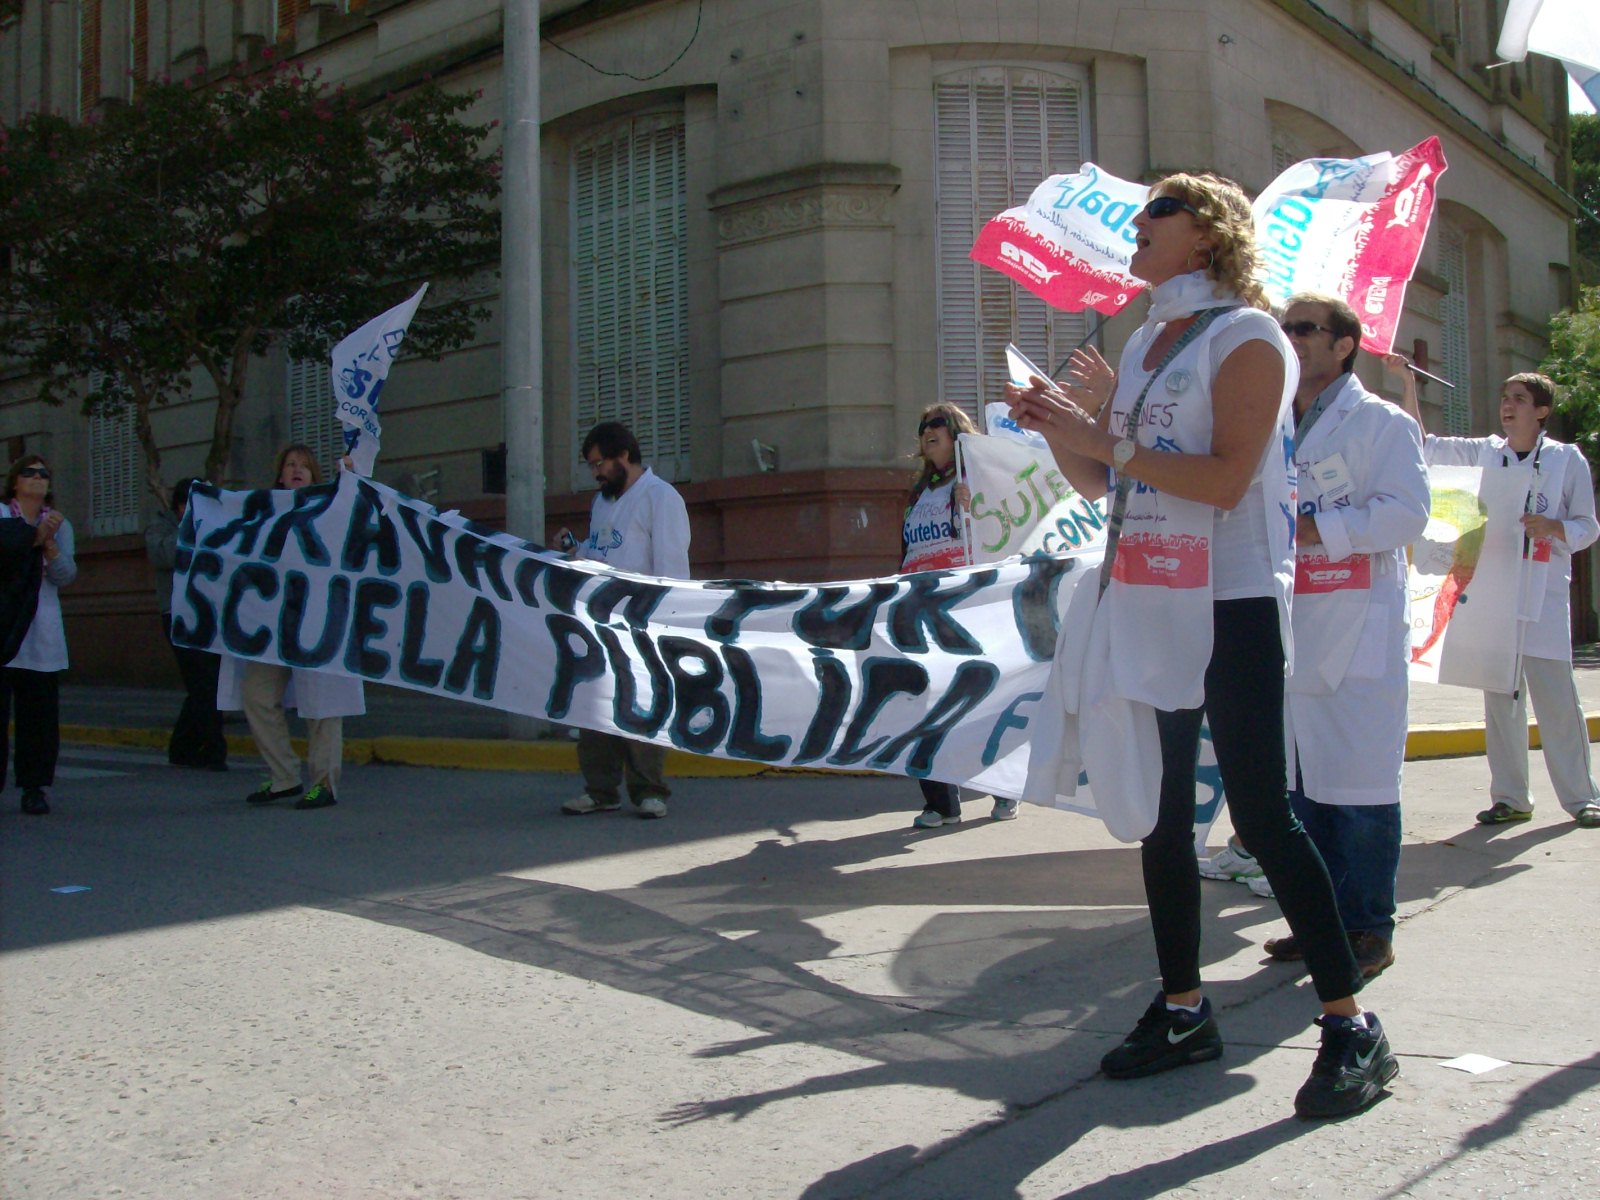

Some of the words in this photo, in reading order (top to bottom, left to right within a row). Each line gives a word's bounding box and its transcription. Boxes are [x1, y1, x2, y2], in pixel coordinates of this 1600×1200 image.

[904, 520, 951, 546] Suteba
[171, 549, 500, 700] SCUELA
[547, 614, 1000, 778] PUBLICA
